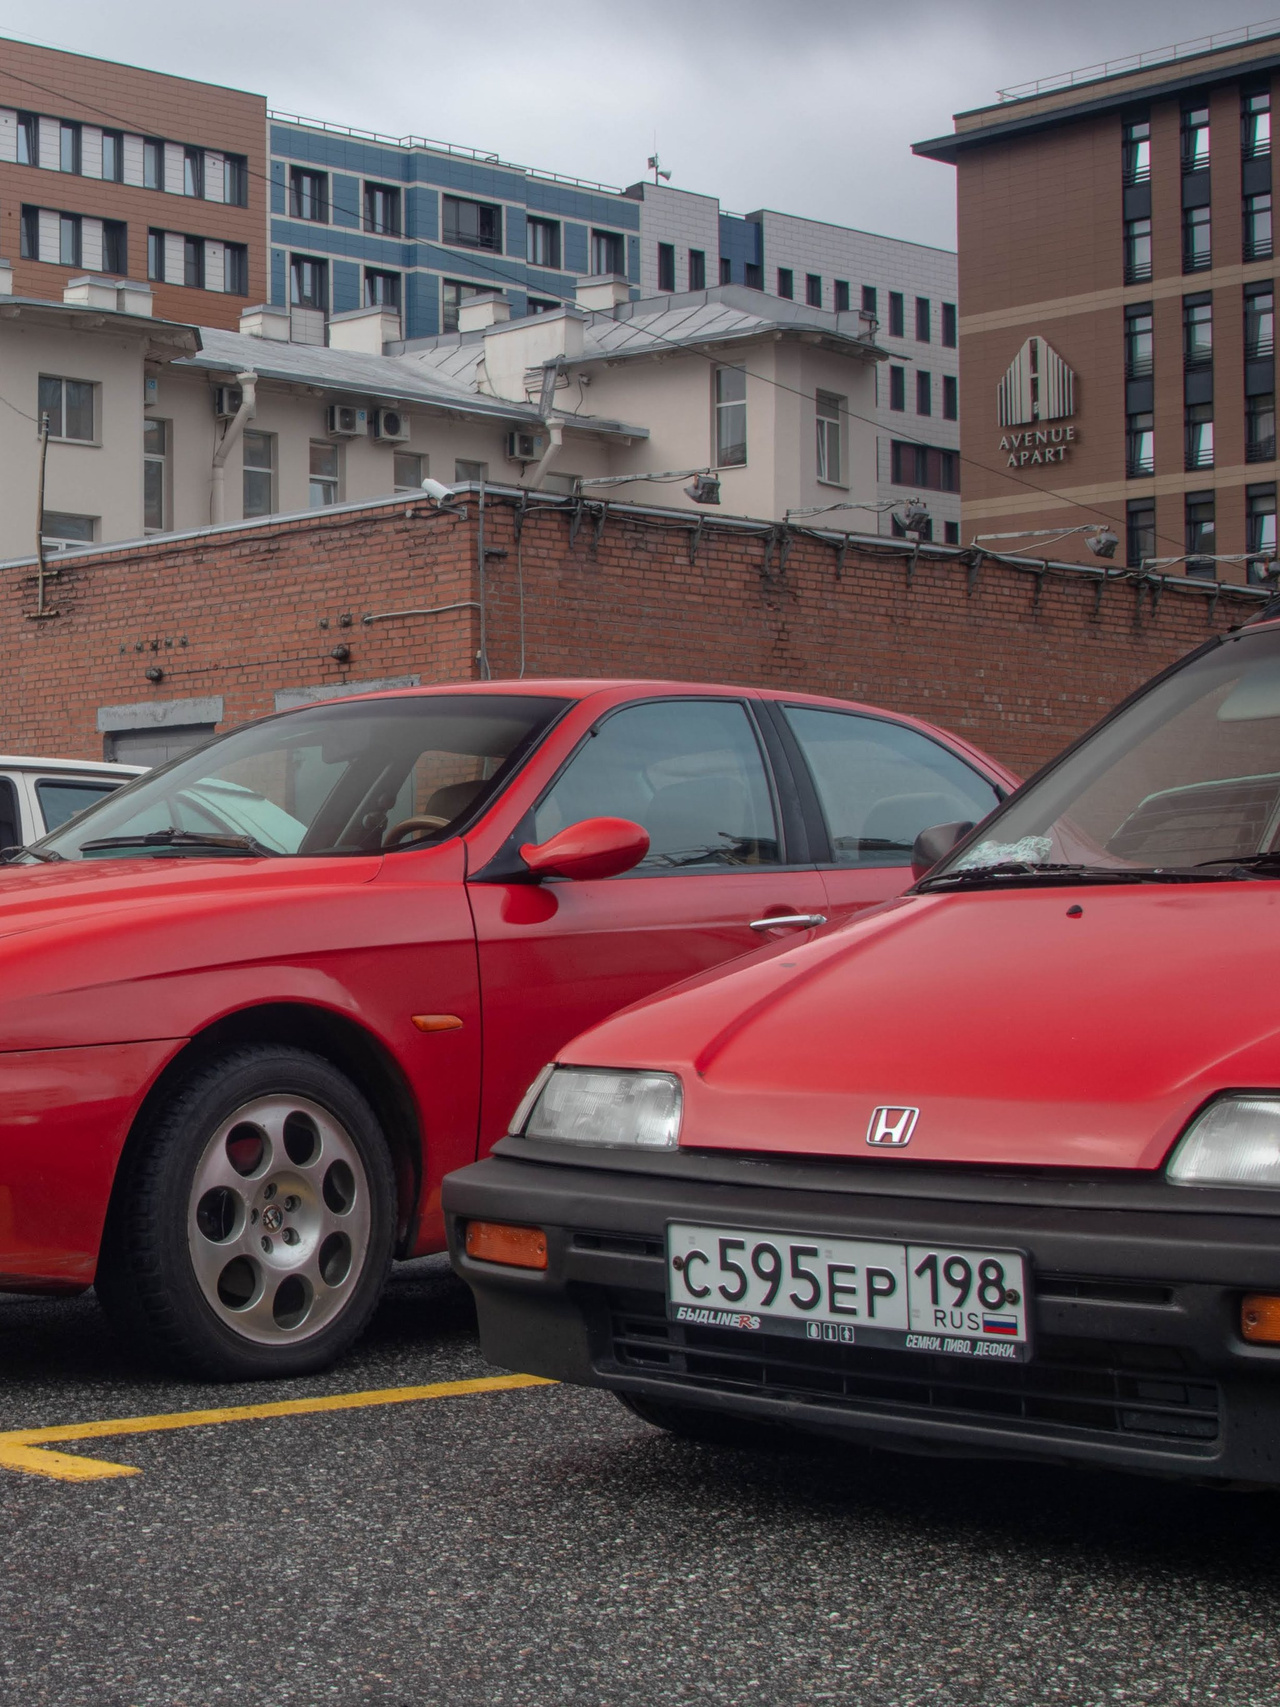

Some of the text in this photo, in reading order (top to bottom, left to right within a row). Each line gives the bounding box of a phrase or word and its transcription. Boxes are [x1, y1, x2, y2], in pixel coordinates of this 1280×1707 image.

[999, 426, 1074, 450] AVENUE
[1007, 446, 1066, 467] APART
[915, 1252, 1007, 1310] 198
[934, 1309, 980, 1330] RUS
[906, 1334, 1016, 1358] СЕМКИ. ПИВО. ДЕФКИ.
